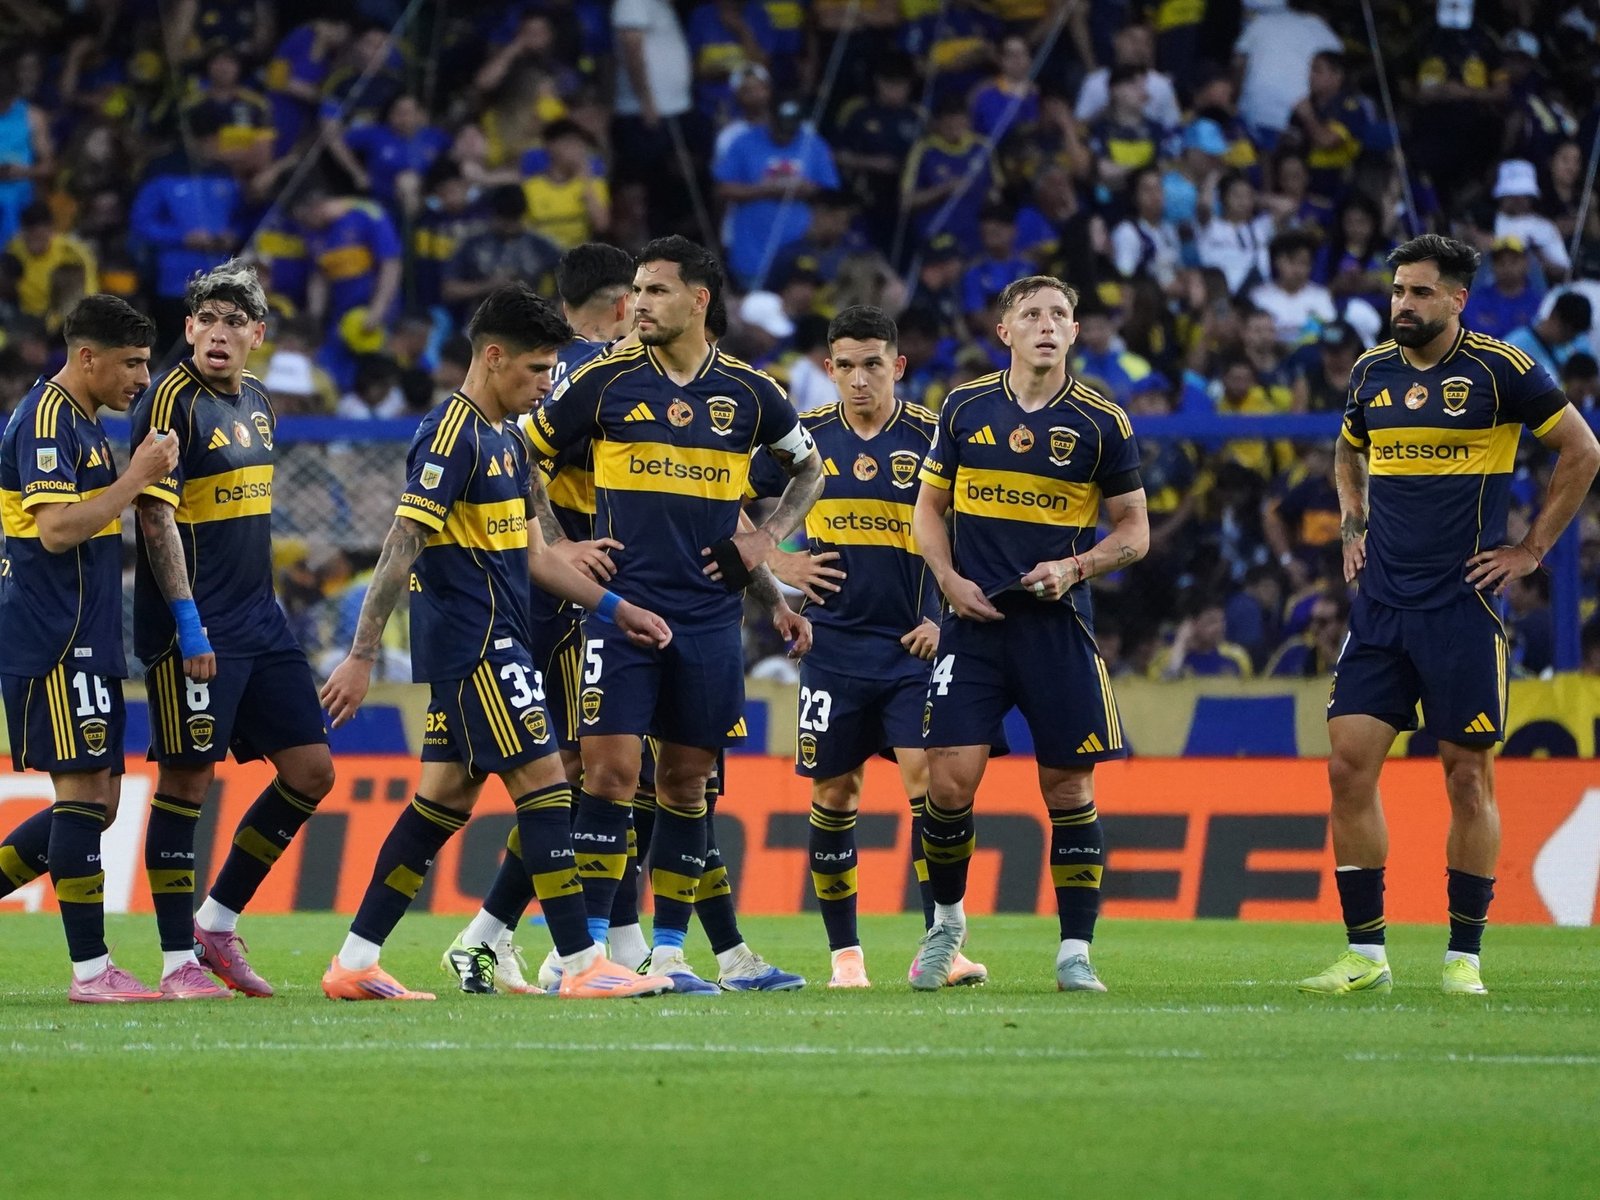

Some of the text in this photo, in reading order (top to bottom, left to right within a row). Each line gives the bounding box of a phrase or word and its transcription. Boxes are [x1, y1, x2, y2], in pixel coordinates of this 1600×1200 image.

[1446, 391, 1465, 399] CABJ
[714, 410, 731, 418] CABJ
[1053, 440, 1072, 449] CABJ
[629, 454, 731, 484] betsson
[895, 464, 913, 472] CABJ
[25, 480, 77, 494] CETROGAR
[967, 480, 1068, 512] betsson
[400, 492, 448, 518] CETROGAR
[584, 639, 604, 685] 5
[73, 670, 111, 717] 16
[800, 686, 832, 733] 23
[529, 720, 544, 730] CABJ
[87, 731, 103, 740] CABJ
[193, 726, 210, 735] CABJ
[574, 832, 617, 843] CABJ
[160, 851, 195, 860] CAB
[814, 848, 853, 861] CABJ
[1058, 847, 1101, 855] CABJ
